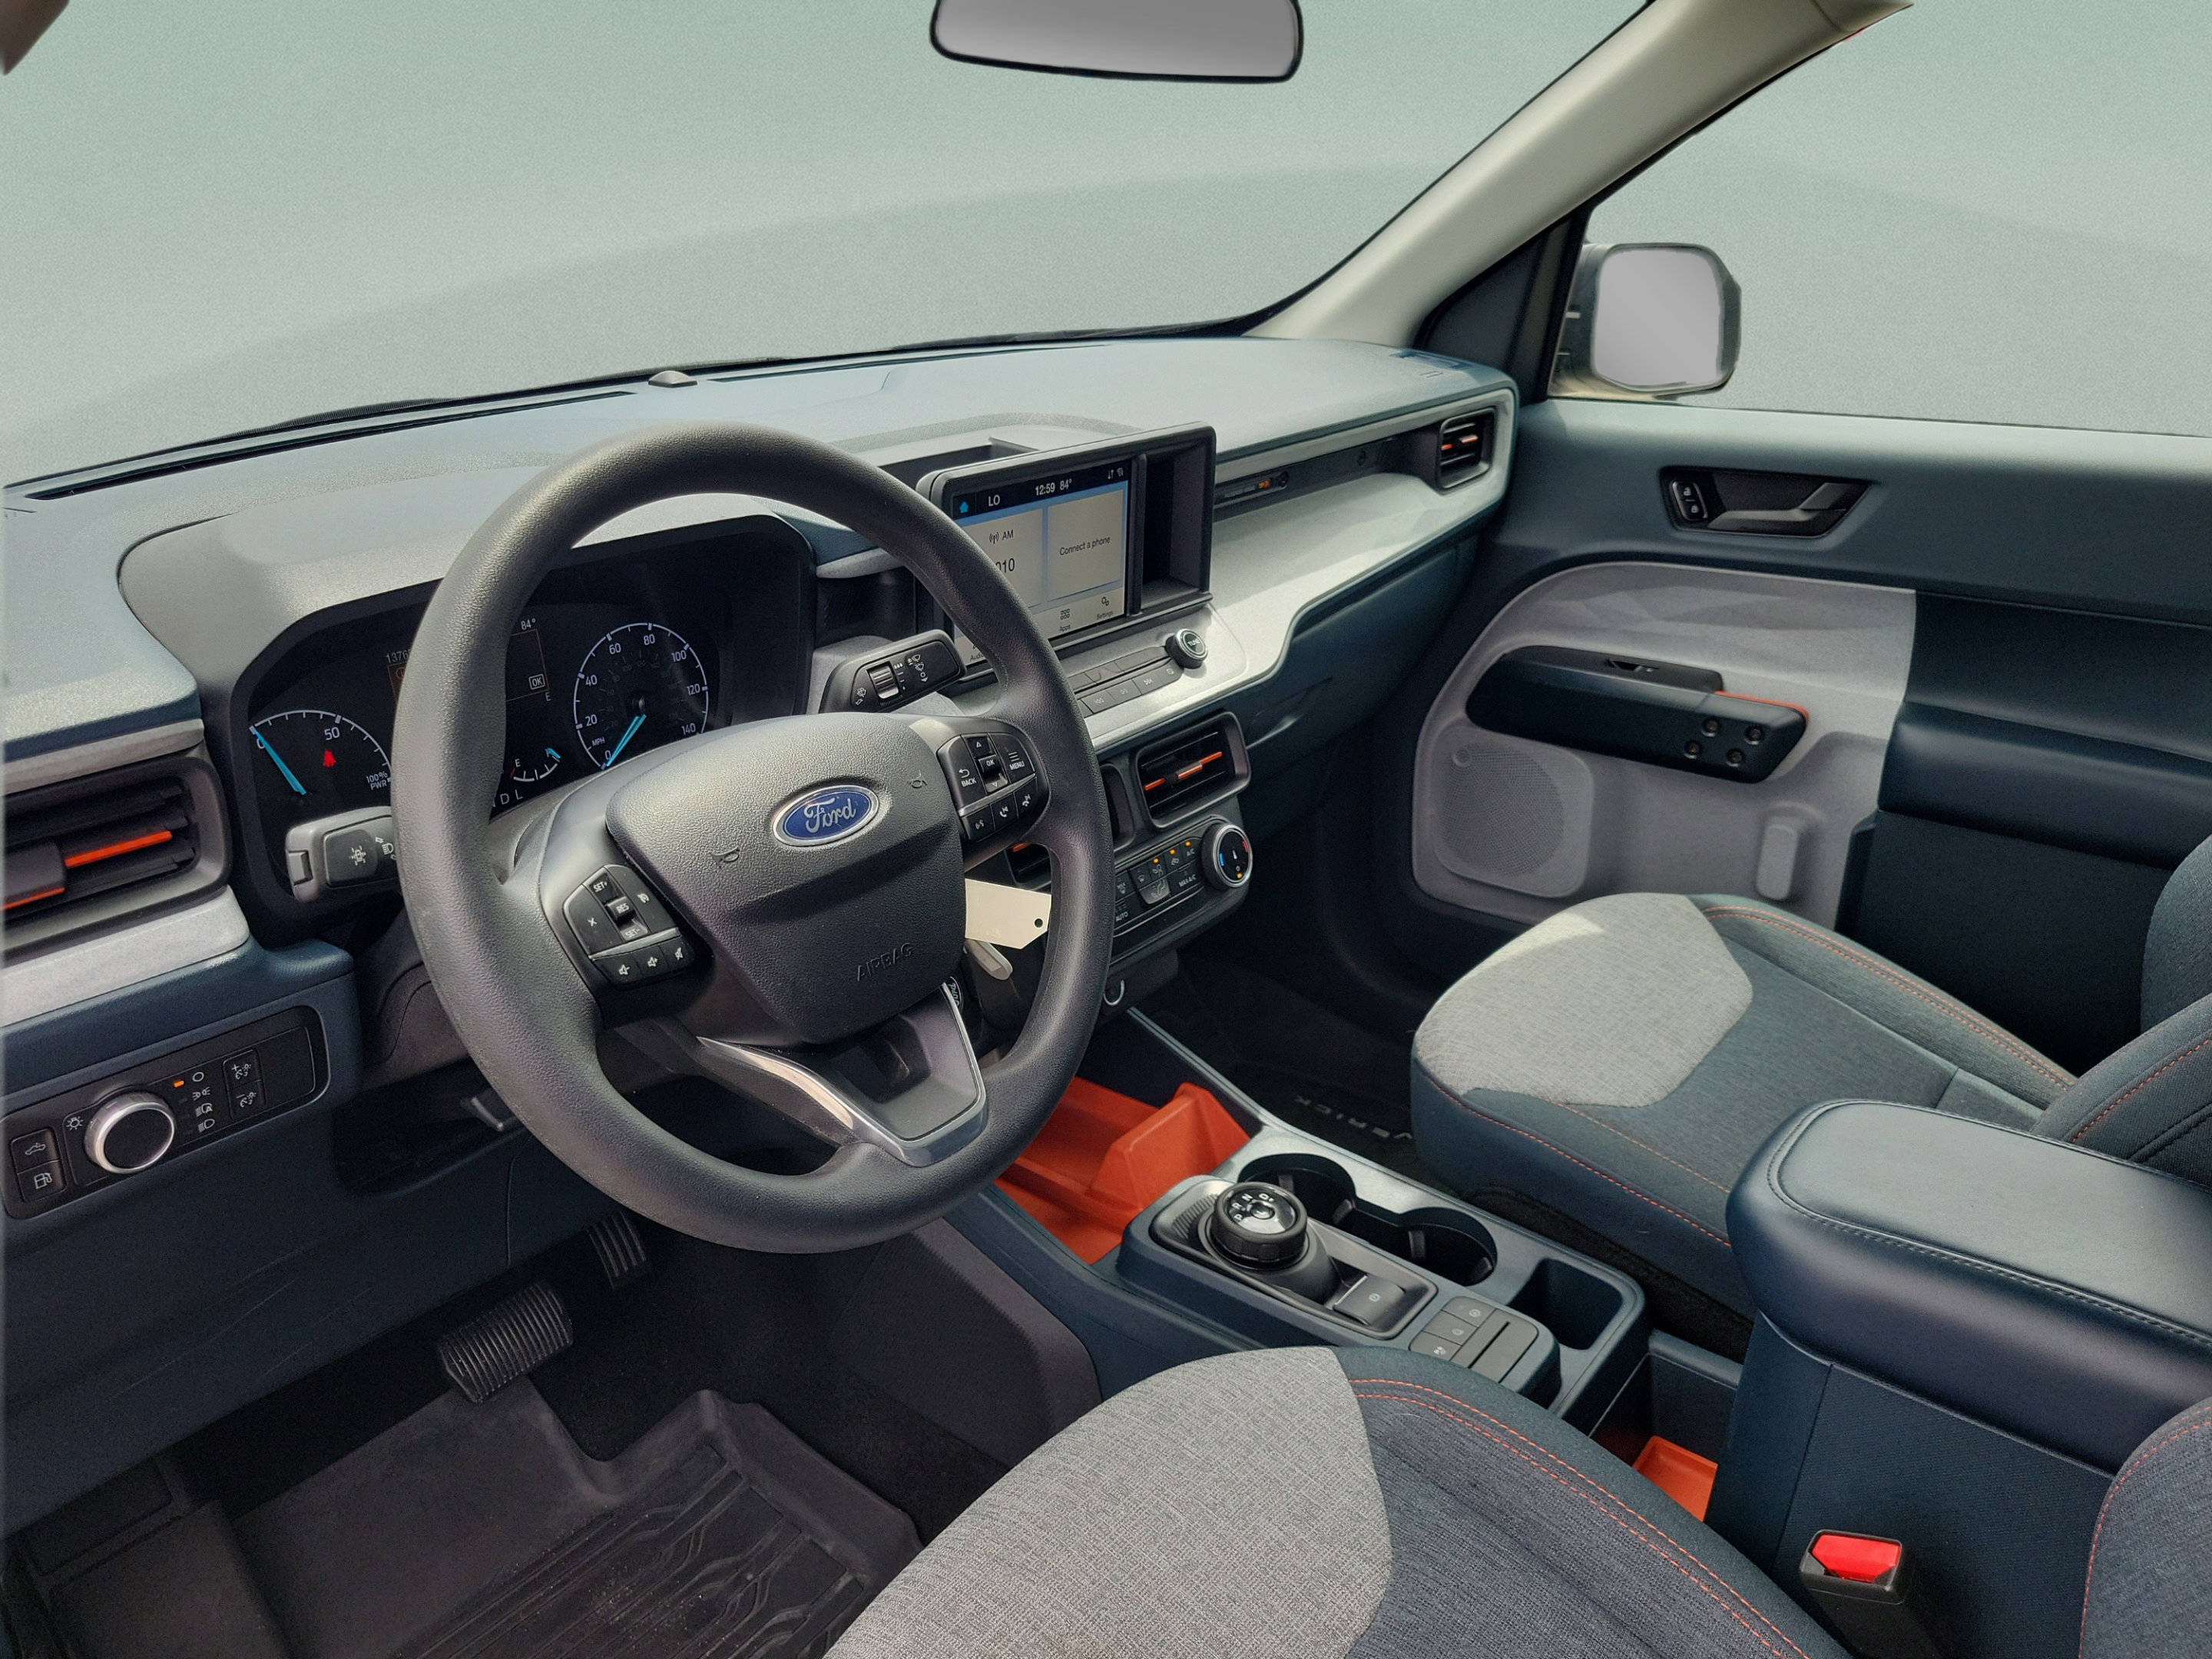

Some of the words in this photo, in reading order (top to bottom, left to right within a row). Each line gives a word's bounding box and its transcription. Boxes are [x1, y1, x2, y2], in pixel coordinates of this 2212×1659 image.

[1035, 482, 1055, 496] 12:59
[988, 495, 1001, 507] LO
[1002, 530, 1014, 541] AM
[1059, 541, 1085, 556] Connect
[1091, 536, 1111, 549] phone
[1059, 624, 1071, 633] Apps
[643, 633, 656, 646] 80
[608, 643, 621, 655] 60
[671, 650, 687, 663] 100
[531, 677, 543, 687] OK
[585, 674, 598, 687] 40
[687, 683, 700, 696] 120
[545, 691, 551, 701] E
[584, 714, 598, 727] 20
[324, 727, 340, 740] 50
[682, 723, 696, 736] 140
[591, 737, 605, 747] MPH
[604, 750, 611, 760] 0
[515, 758, 521, 767] E
[1008, 761, 1025, 771] MENU
[366, 771, 389, 783] 100%
[961, 777, 977, 788] BACK
[370, 780, 388, 791] PWR
[803, 796, 856, 833] Ford
[615, 902, 630, 914] RES
[1115, 911, 1129, 922] AUTO
[856, 942, 913, 982] AIRBAG
[1242, 1193, 1253, 1202] N
[1232, 1202, 1243, 1210] R
[1233, 1214, 1243, 1223] P
